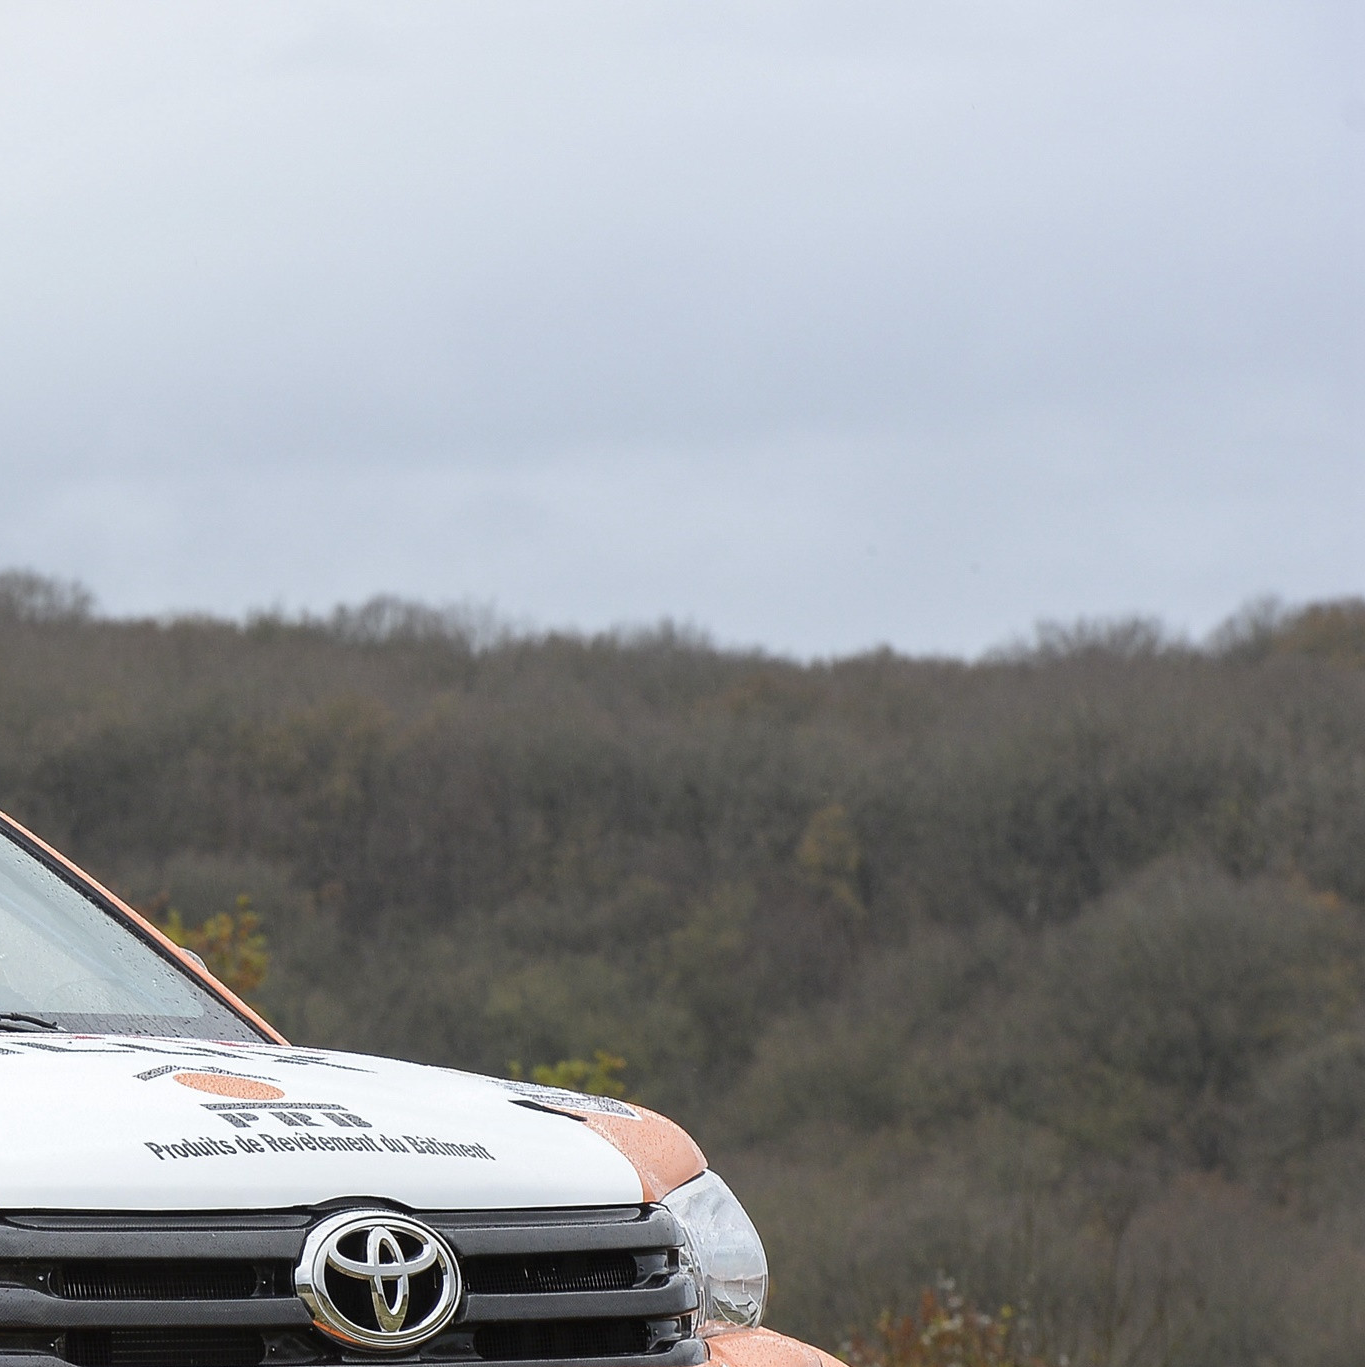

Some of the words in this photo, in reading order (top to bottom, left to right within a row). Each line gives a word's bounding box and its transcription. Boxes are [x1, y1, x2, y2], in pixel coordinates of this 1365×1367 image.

[144, 1136, 239, 1161] Produits
[235, 1133, 262, 1154] de
[257, 1131, 382, 1154] Revêtement
[378, 1133, 407, 1154] du
